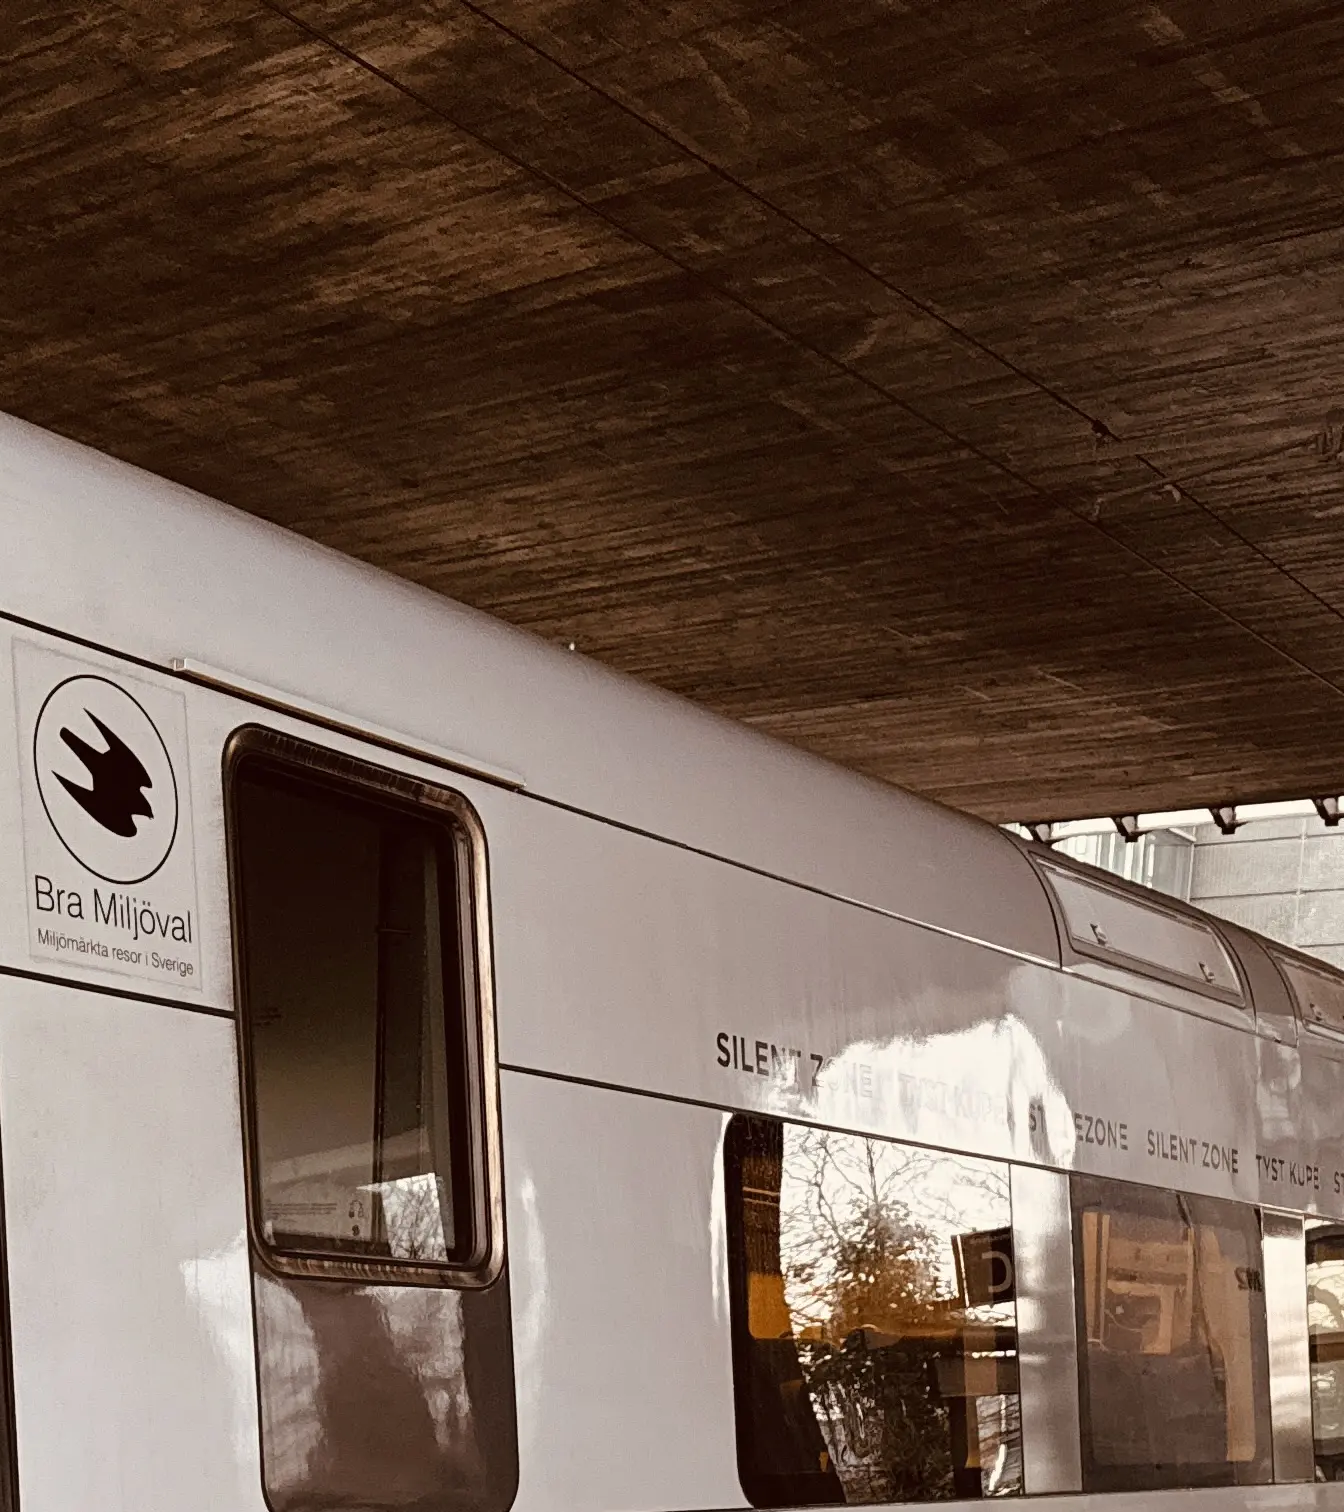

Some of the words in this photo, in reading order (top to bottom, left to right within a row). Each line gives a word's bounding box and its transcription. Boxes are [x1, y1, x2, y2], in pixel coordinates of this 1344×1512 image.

[34, 874, 84, 920] Bra
[94, 888, 192, 943] Miljöval
[38, 927, 109, 957] Miljömärkta
[112, 947, 142, 964] resor
[145, 952, 149, 966] i
[152, 952, 194, 977] Sverige
[1147, 1129, 1197, 1166] SILENT
[1202, 1141, 1239, 1174] ZONE
[1256, 1154, 1285, 1181] TYST
